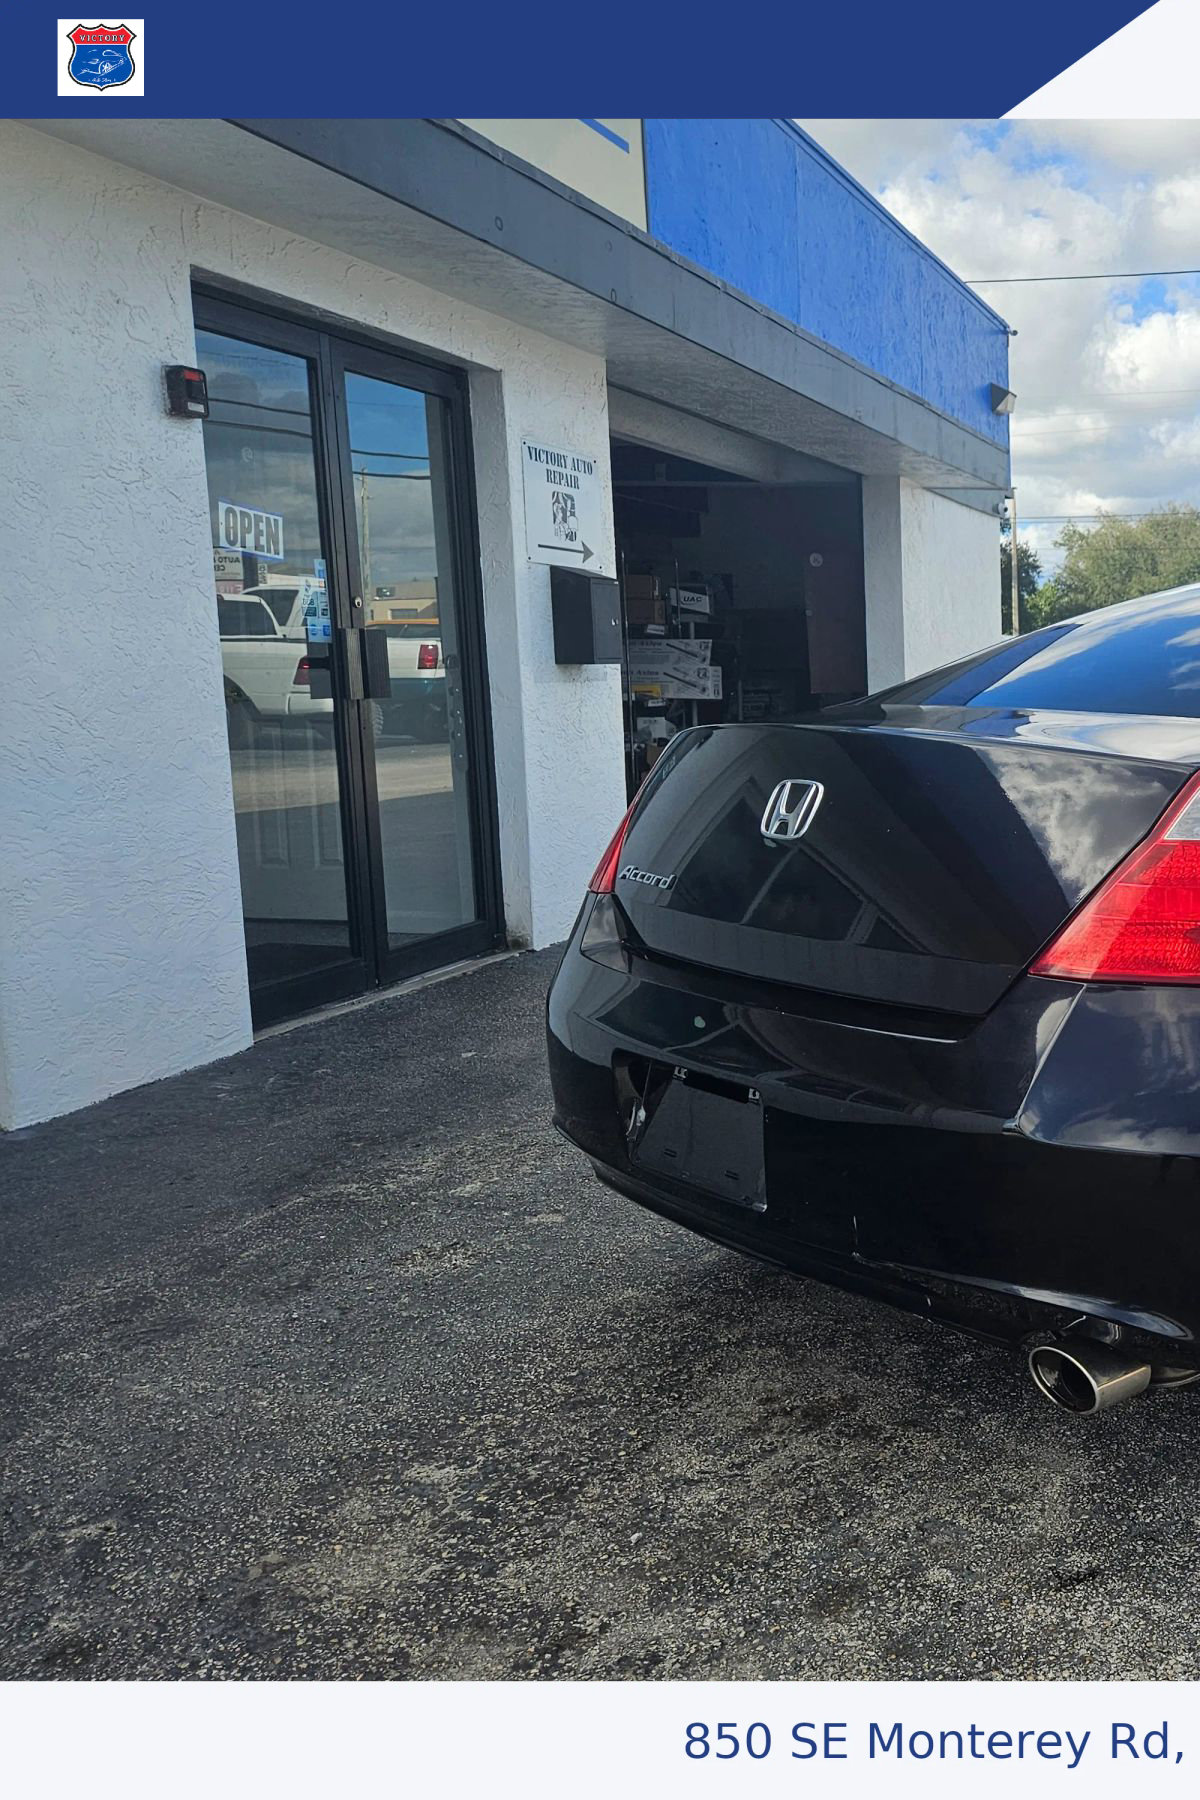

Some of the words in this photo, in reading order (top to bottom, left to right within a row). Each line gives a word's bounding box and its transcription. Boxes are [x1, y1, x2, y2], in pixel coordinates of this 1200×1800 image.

[527, 445, 569, 470] VICTORY
[570, 456, 594, 476] AUTO
[546, 468, 580, 490] REPAIR
[224, 505, 281, 557] OPEN
[618, 865, 676, 889] Accord
